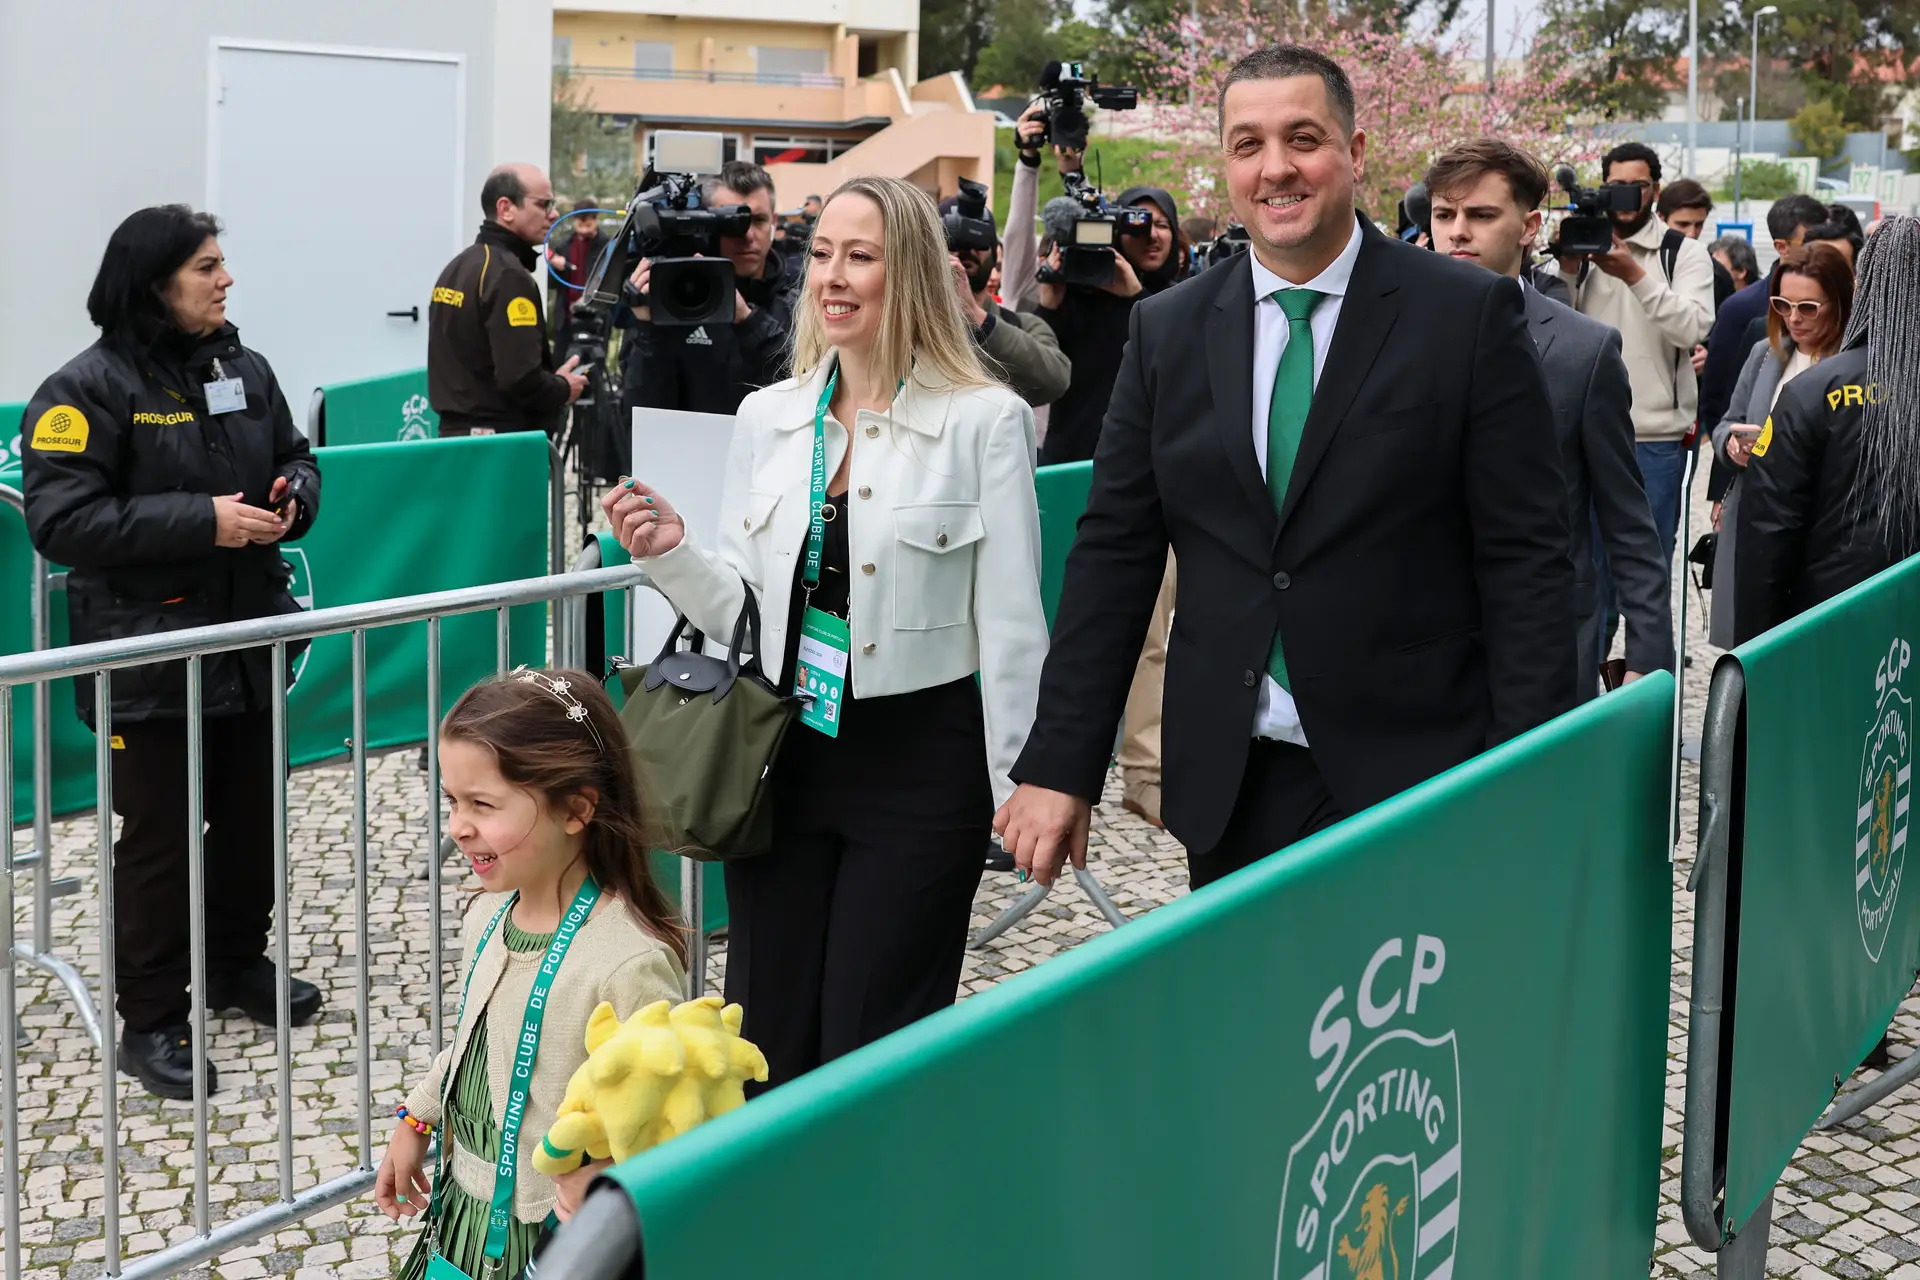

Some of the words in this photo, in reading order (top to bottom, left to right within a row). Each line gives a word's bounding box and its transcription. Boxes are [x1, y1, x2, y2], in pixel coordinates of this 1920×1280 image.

[36, 436, 81, 446] PROSEGUR
[813, 435, 823, 492] SPORTING
[811, 500, 823, 541] CLUBE
[807, 551, 818, 568] DE
[1875, 637, 1911, 709] SCP
[1865, 709, 1907, 791] SPORTING
[1861, 866, 1900, 931] PORTUGAL
[499, 1090, 525, 1177] SPORTING
[515, 1023, 538, 1079] CLUBE
[530, 985, 547, 1009] DE
[542, 894, 594, 975] PORTUGAL
[1309, 933, 1446, 1093] SCP
[1296, 1068, 1446, 1254] SPORTING
